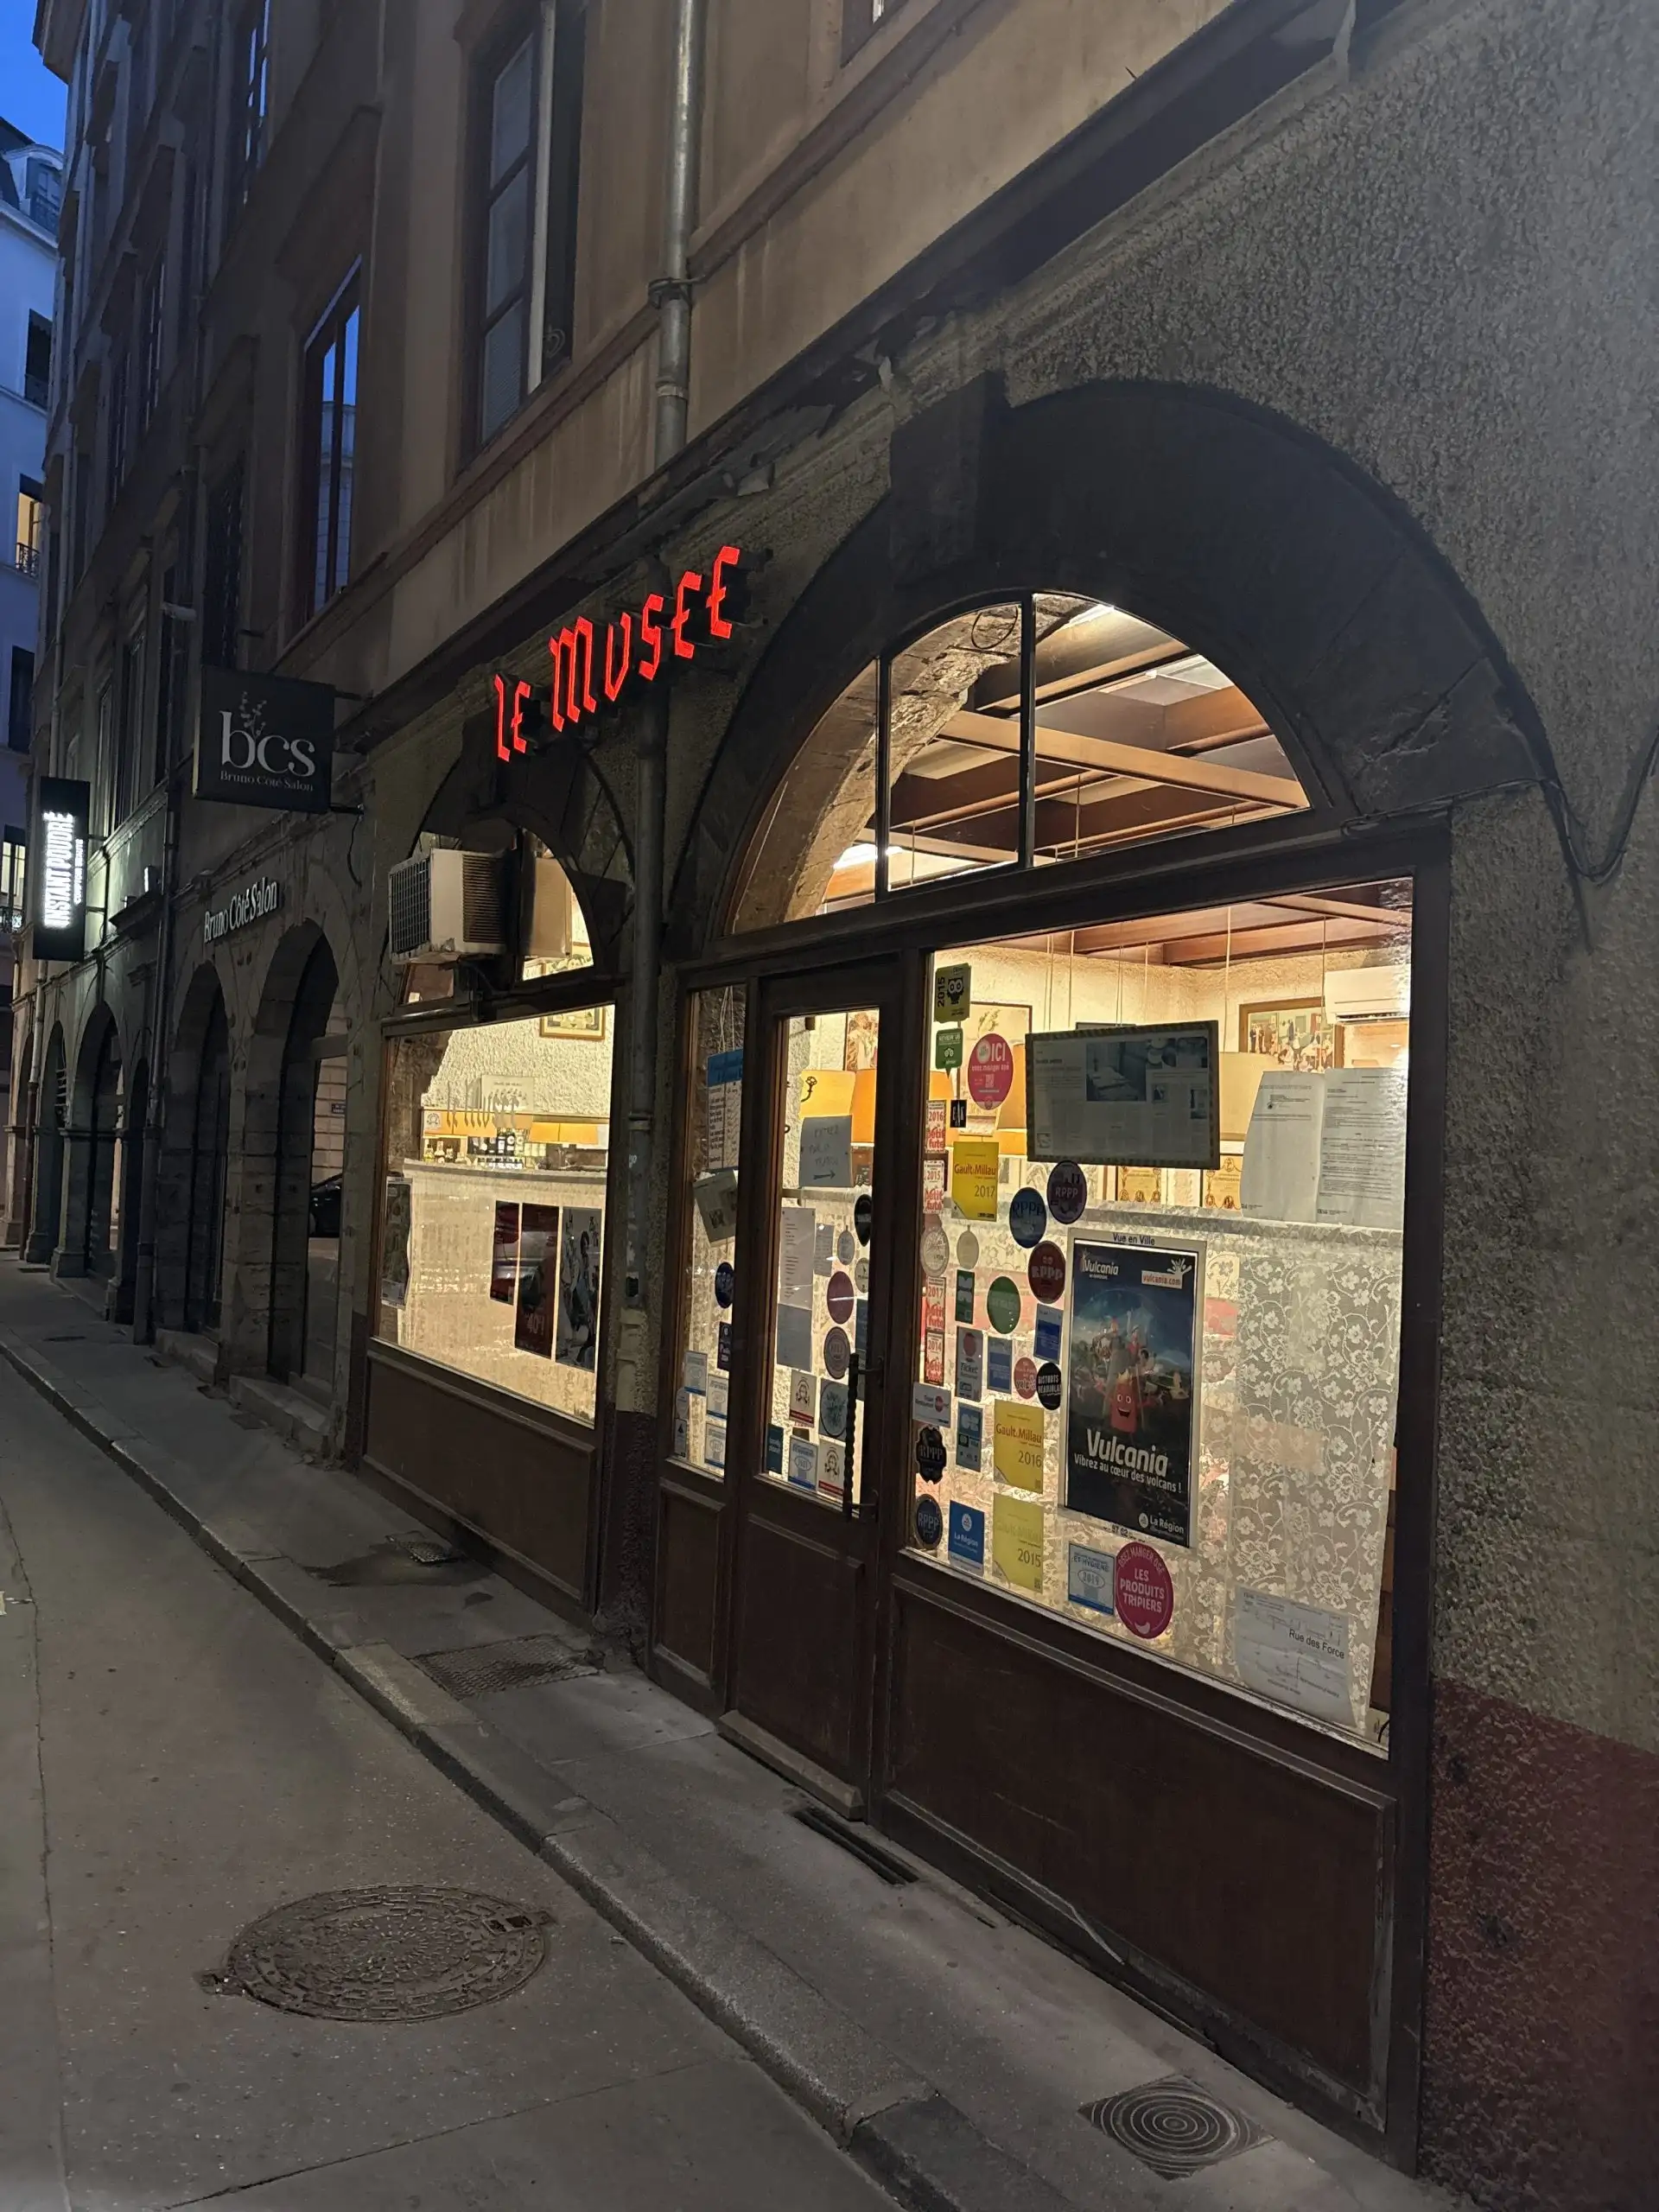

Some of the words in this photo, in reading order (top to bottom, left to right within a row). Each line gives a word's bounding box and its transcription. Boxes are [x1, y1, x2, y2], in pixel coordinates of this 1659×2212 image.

[219, 710, 315, 777] bcs
[220, 770, 255, 784] Bruno
[283, 779, 313, 791] Salon
[43, 868, 72, 929] INSTANT
[204, 909, 229, 943] Bruno
[229, 888, 250, 931] Côté
[250, 876, 277, 922] Salon
[937, 976, 946, 1007] 2015
[991, 1042, 1006, 1062] ICI
[929, 1110, 944, 1122] 2016
[927, 1170, 941, 1181] 2015
[975, 1185, 995, 1198] 2017
[1113, 1233, 1126, 1243] Vue
[1140, 1235, 1155, 1246] Ville
[1084, 1258, 1119, 1276] Vulcania
[1142, 1274, 1181, 1287] vulcania.com
[928, 1287, 944, 1297] 2017
[961, 1363, 978, 1374] Ticket
[1018, 1450, 1042, 1466] 2016
[1087, 1428, 1168, 1478] Vulcania
[1074, 1453, 1098, 1470] Vibrez
[1099, 1462, 1109, 1473] au
[1130, 1470, 1145, 1484] des
[1147, 1476, 1177, 1493] volcans
[918, 1512, 939, 1531] RPPP
[1150, 1515, 1158, 1526] La
[1159, 1517, 1184, 1535] Région
[954, 1531, 961, 1540] La
[961, 1533, 978, 1548] Région
[1017, 1548, 1041, 1568] 2015
[1130, 1547, 1154, 1563] MANGER
[1134, 1567, 1149, 1582] LES
[1120, 1578, 1165, 1599] PRODUITS
[1123, 1592, 1162, 1614] TRIPIERS
[1288, 1628, 1305, 1643] Rue
[1306, 1636, 1319, 1649] des
[1322, 1642, 1345, 1659] Force
